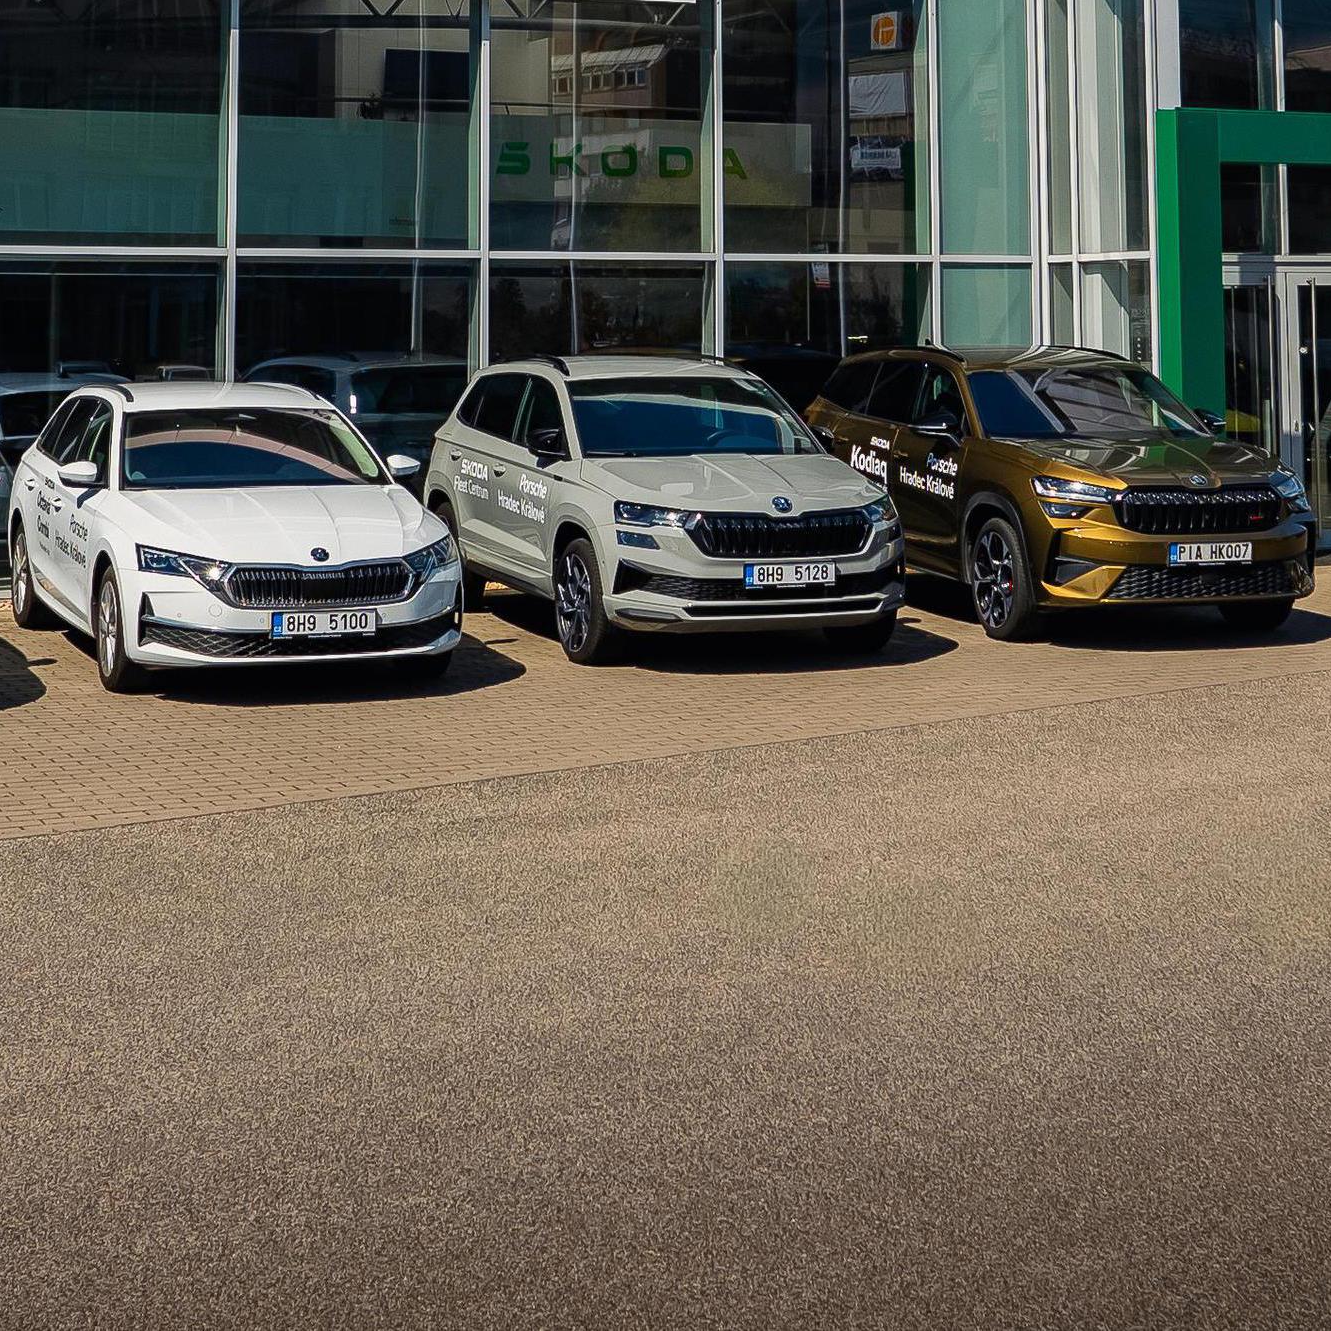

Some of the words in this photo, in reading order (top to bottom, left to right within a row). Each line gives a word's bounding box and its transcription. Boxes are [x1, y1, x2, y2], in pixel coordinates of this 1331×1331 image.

[850, 444, 888, 485] Kodiaq
[927, 452, 958, 476] Porsche
[454, 475, 468, 493] Fleet
[519, 473, 547, 499] Porsche
[899, 466, 926, 490] Hradec
[497, 489, 520, 514] Hradec
[1210, 543, 1250, 560] HK007
[757, 566, 784, 582] 8H9
[794, 564, 829, 581] 5128
[287, 614, 316, 633] 8H9
[329, 613, 368, 631] 5100
